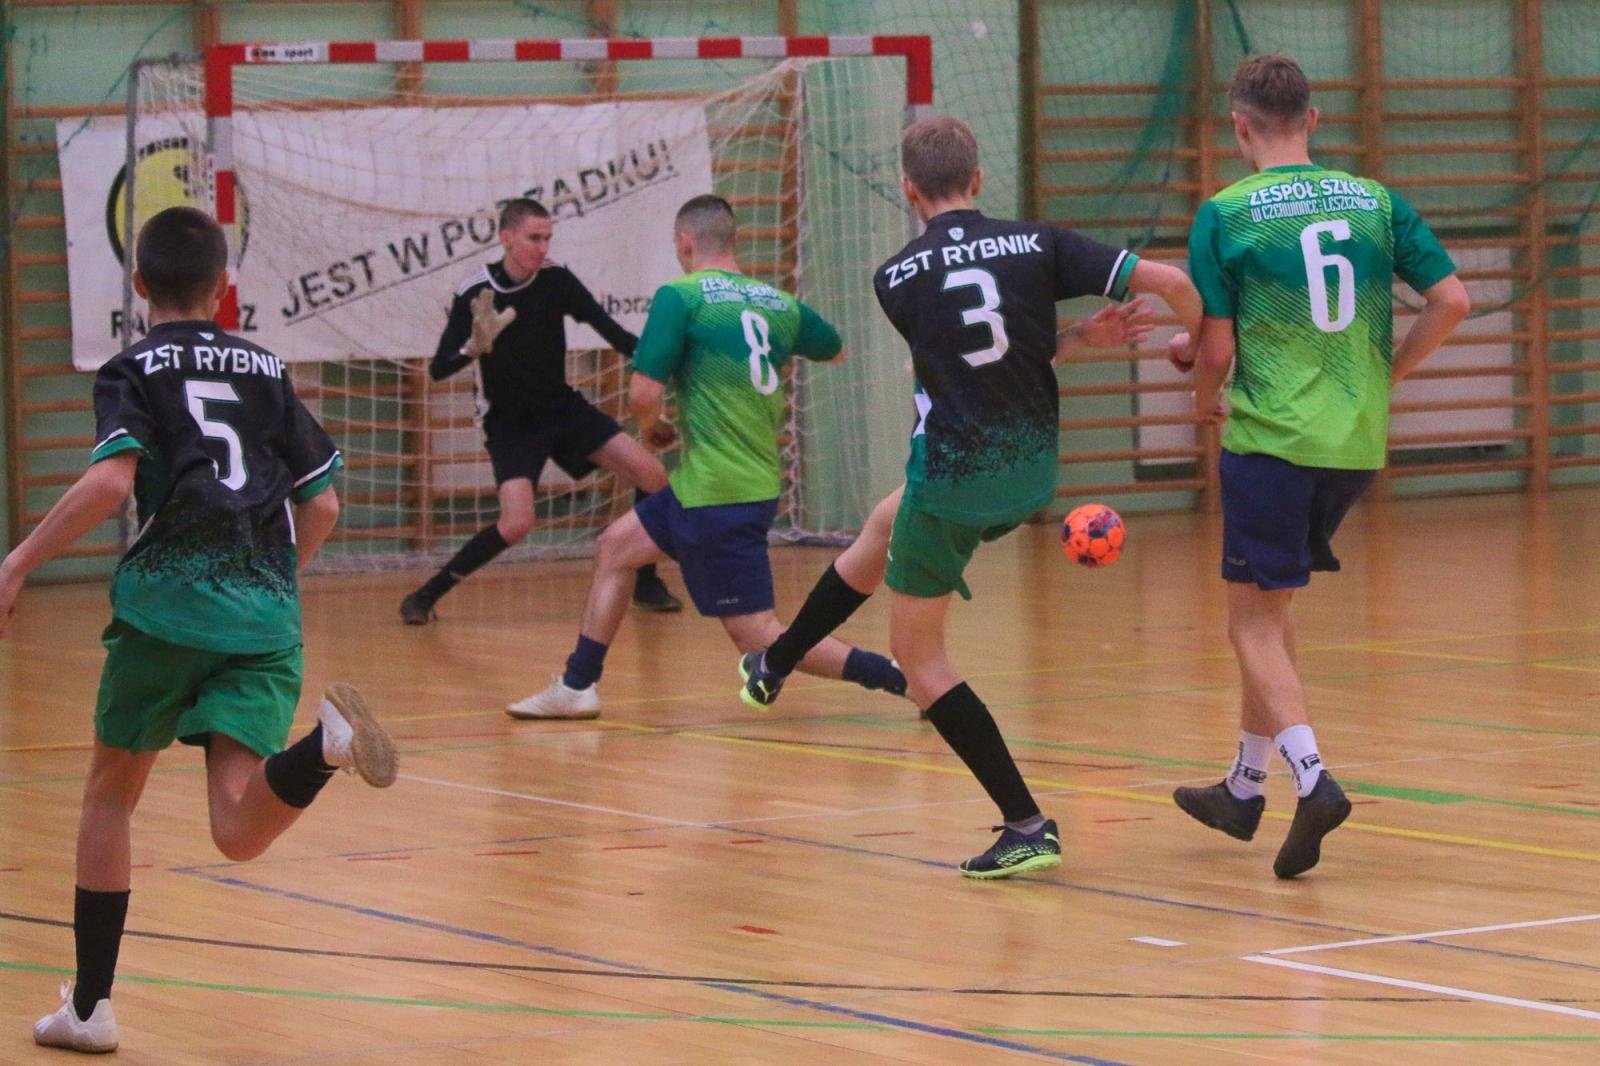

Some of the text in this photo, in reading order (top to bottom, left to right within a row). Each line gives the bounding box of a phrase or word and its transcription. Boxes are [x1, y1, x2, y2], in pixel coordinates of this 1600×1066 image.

[1248, 176, 1318, 206] ZESPÓŁ
[281, 250, 377, 319] JEST
[388, 232, 430, 275] W
[885, 233, 1043, 288] ZST RYBNIK
[1300, 219, 1356, 332] 6
[135, 344, 184, 376] ZST
[740, 309, 779, 395] 8
[942, 267, 1010, 368] 3
[184, 378, 249, 491] 5
